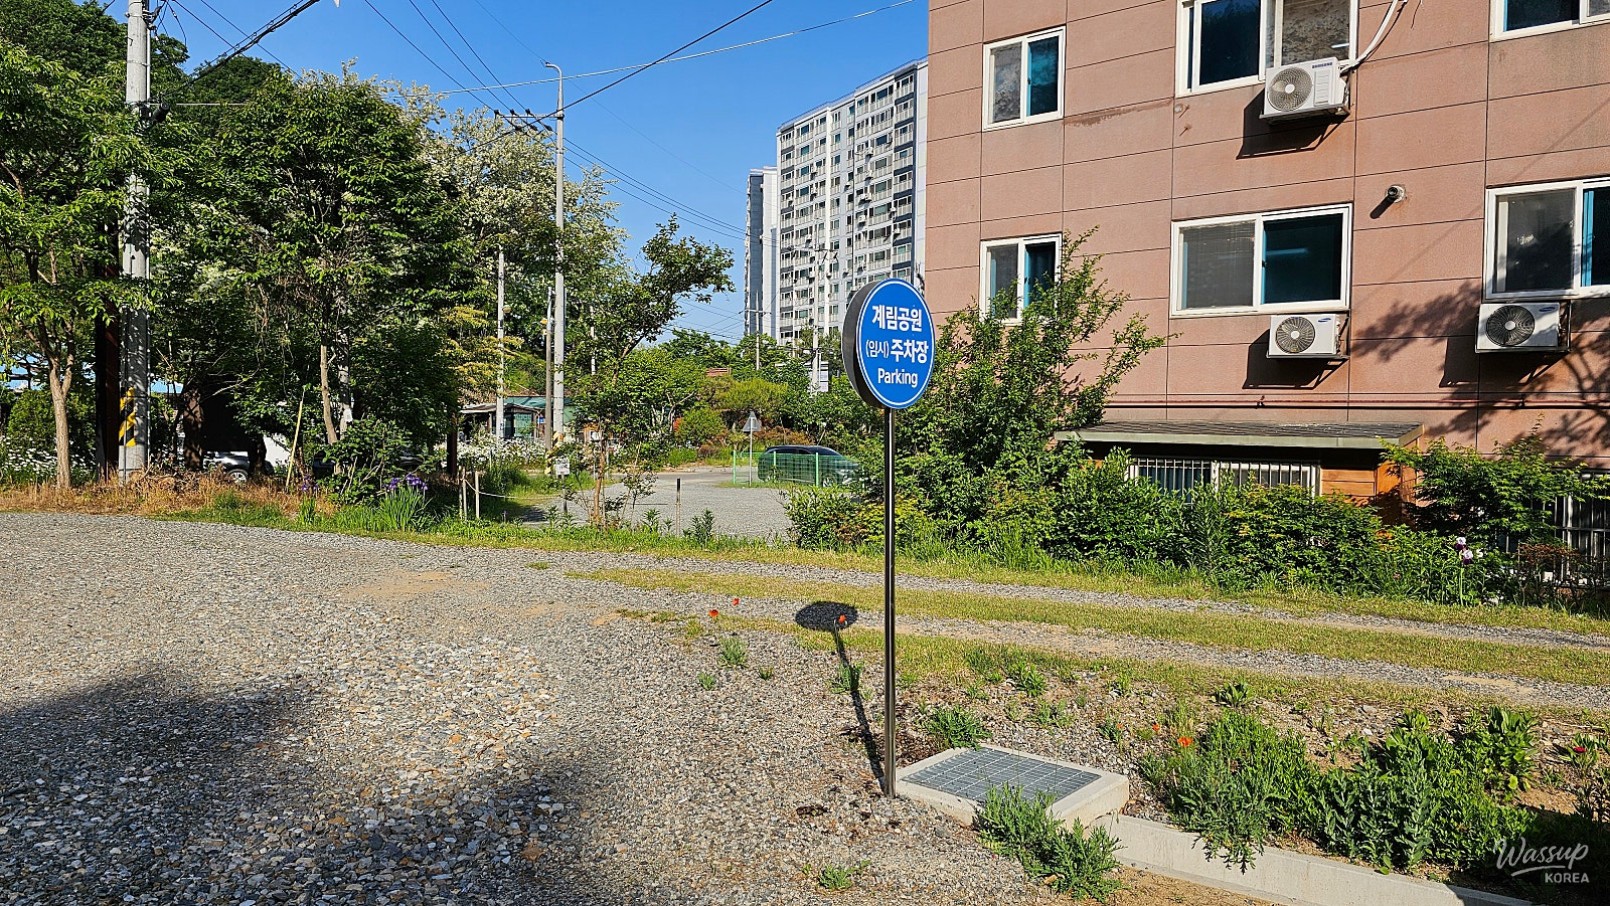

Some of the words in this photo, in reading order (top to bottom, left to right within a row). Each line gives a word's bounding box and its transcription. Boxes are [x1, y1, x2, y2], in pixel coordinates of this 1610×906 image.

[872, 304, 922, 332] 계림공원
[866, 339, 889, 358] (임시)
[890, 338, 929, 364] 주차장
[878, 367, 918, 388] Parking
